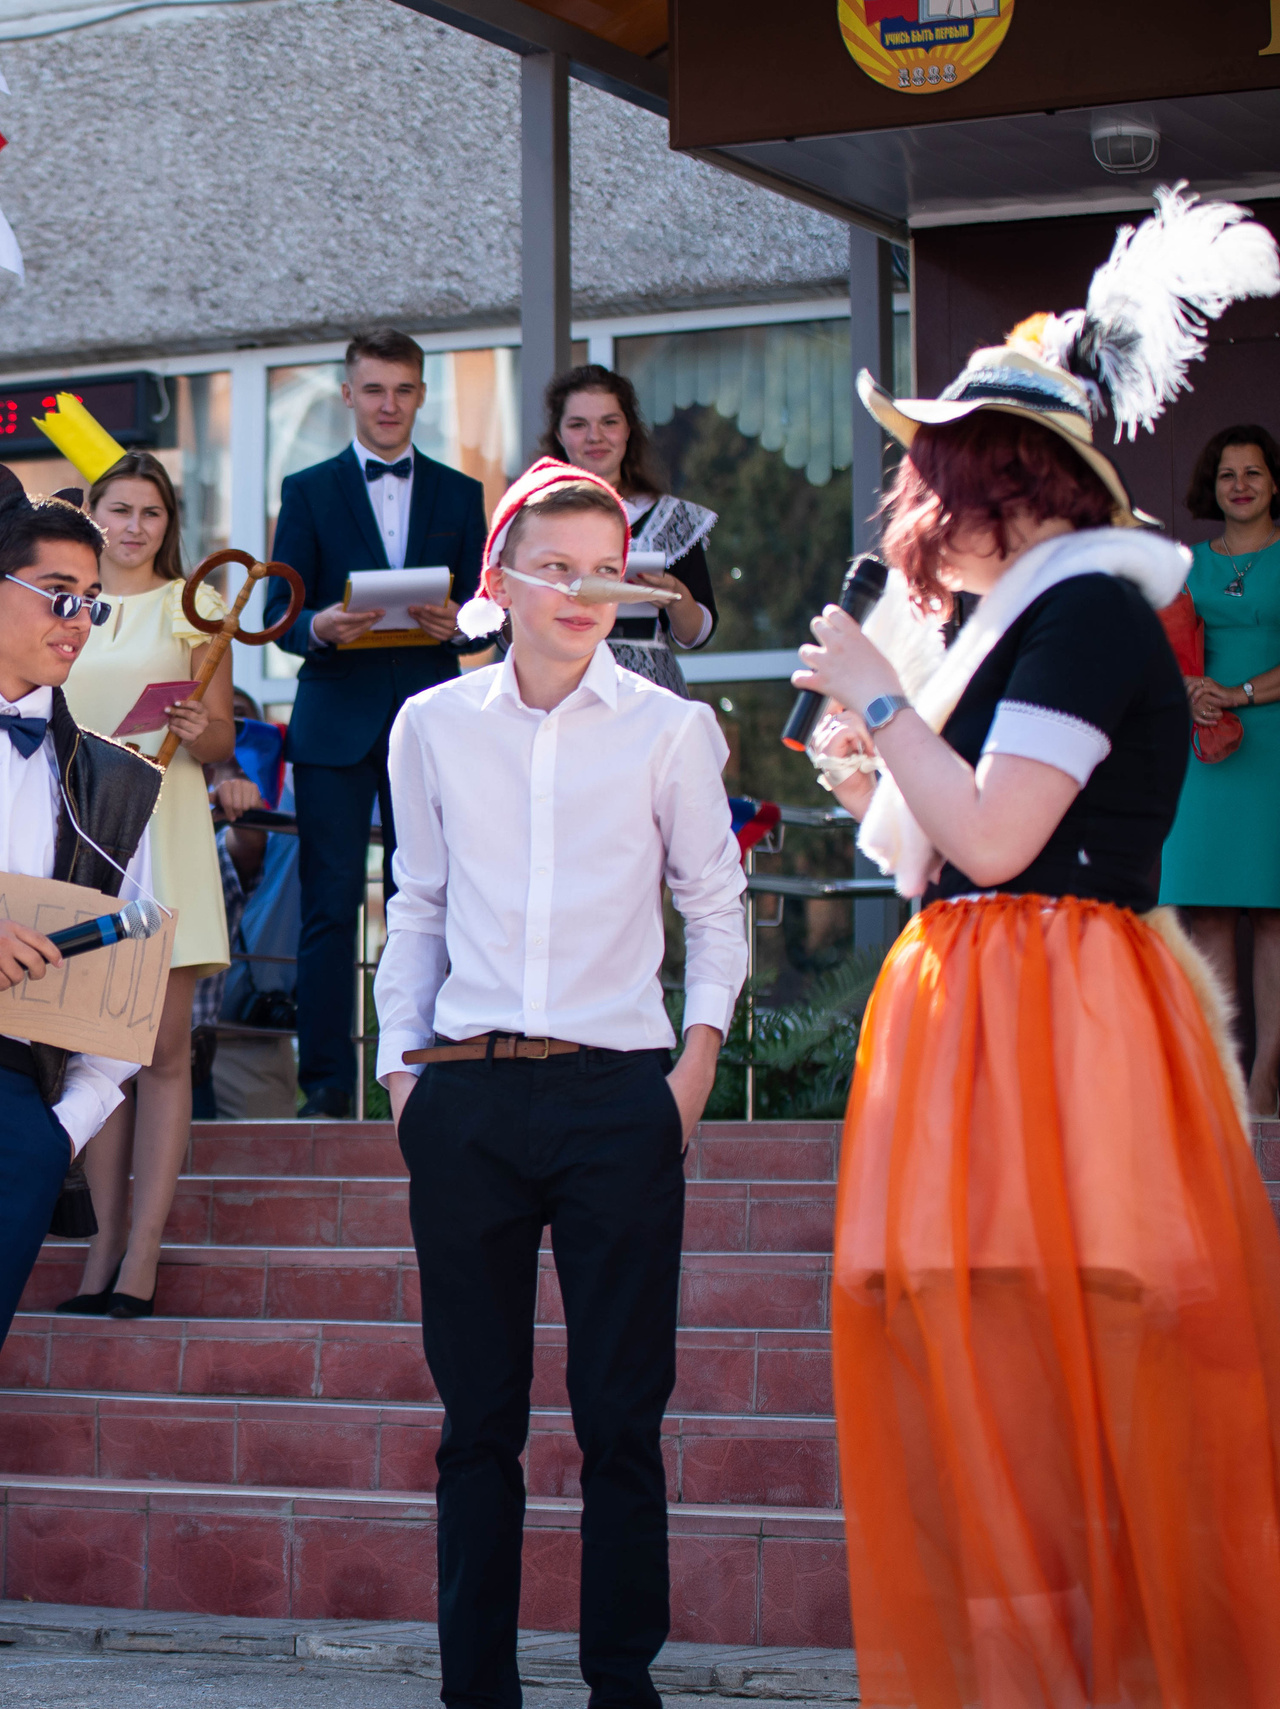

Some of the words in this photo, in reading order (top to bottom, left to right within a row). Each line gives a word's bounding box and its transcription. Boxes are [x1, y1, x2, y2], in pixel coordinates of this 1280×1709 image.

[884, 31, 910, 46] УЧИСЬ
[910, 28, 934, 43] БЫТЬ
[934, 24, 970, 40] ПЕРВЫМ
